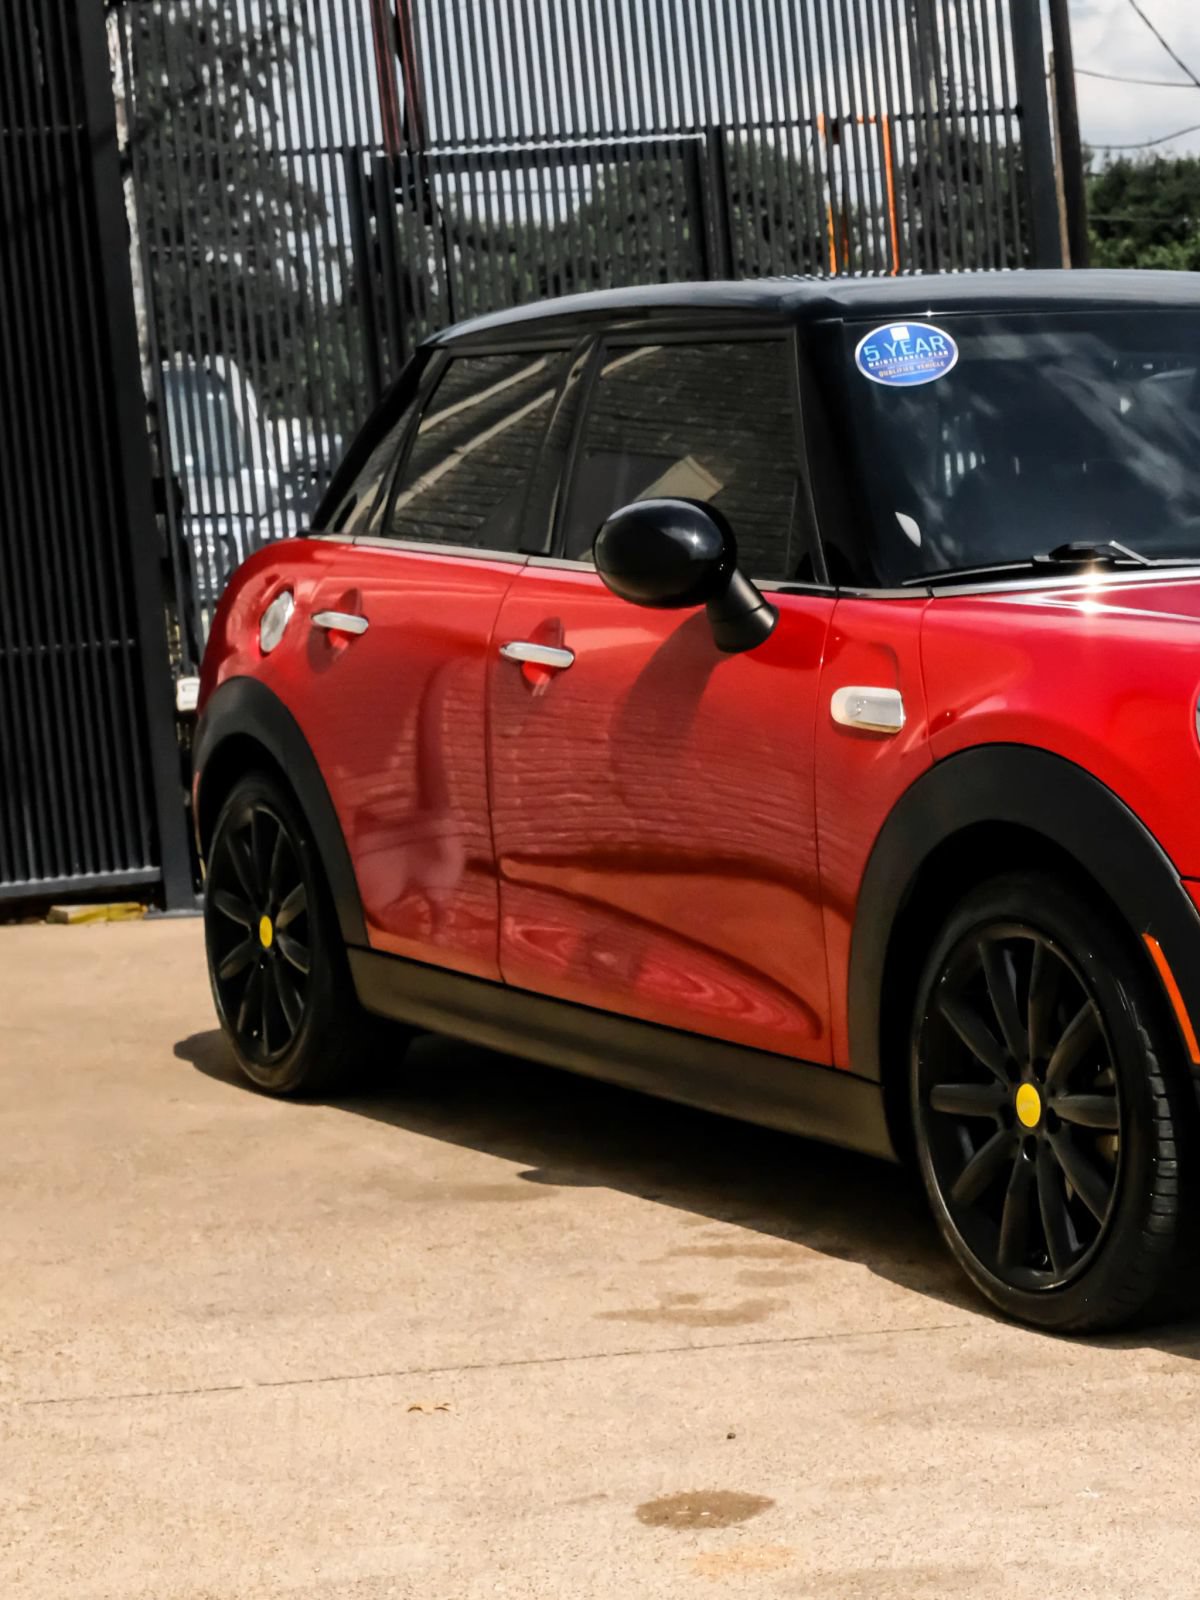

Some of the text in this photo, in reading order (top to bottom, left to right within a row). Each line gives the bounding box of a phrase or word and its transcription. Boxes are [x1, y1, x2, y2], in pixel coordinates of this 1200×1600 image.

[863, 336, 946, 362] 5 YEAR
[868, 353, 924, 368] MAINTENANCE
[928, 350, 949, 358] PLAN
